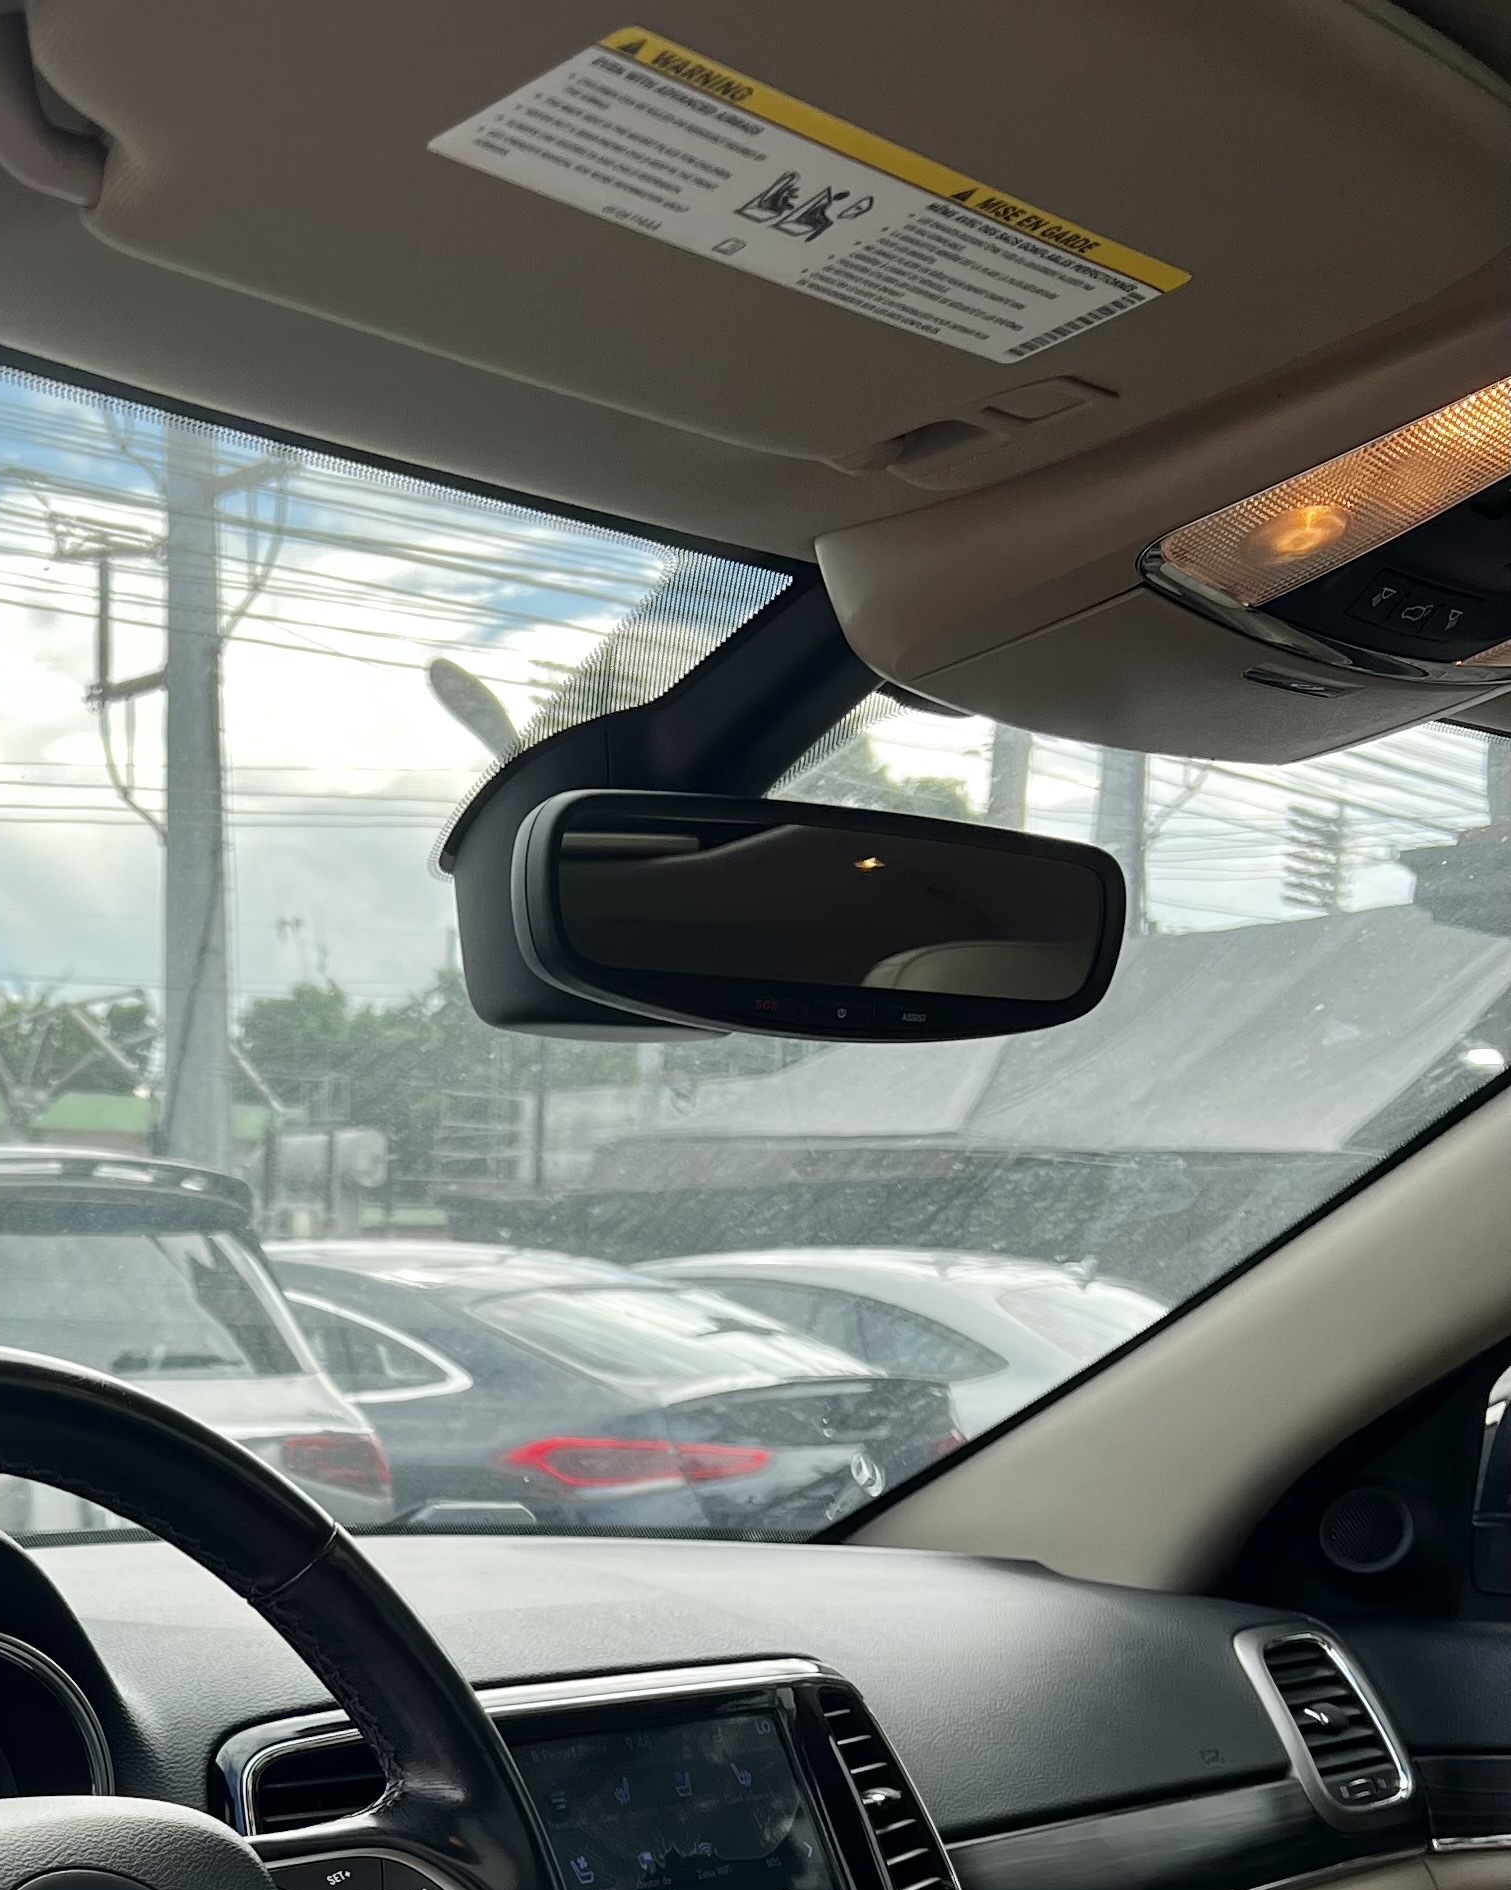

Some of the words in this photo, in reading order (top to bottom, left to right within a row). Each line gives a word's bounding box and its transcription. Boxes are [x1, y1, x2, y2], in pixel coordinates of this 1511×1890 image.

[651, 51, 755, 101] WARNING
[976, 197, 1024, 223] MISE
[1017, 211, 1051, 235] EN
[1042, 223, 1103, 253] GARDE
[326, 1870, 352, 1886] SET+
